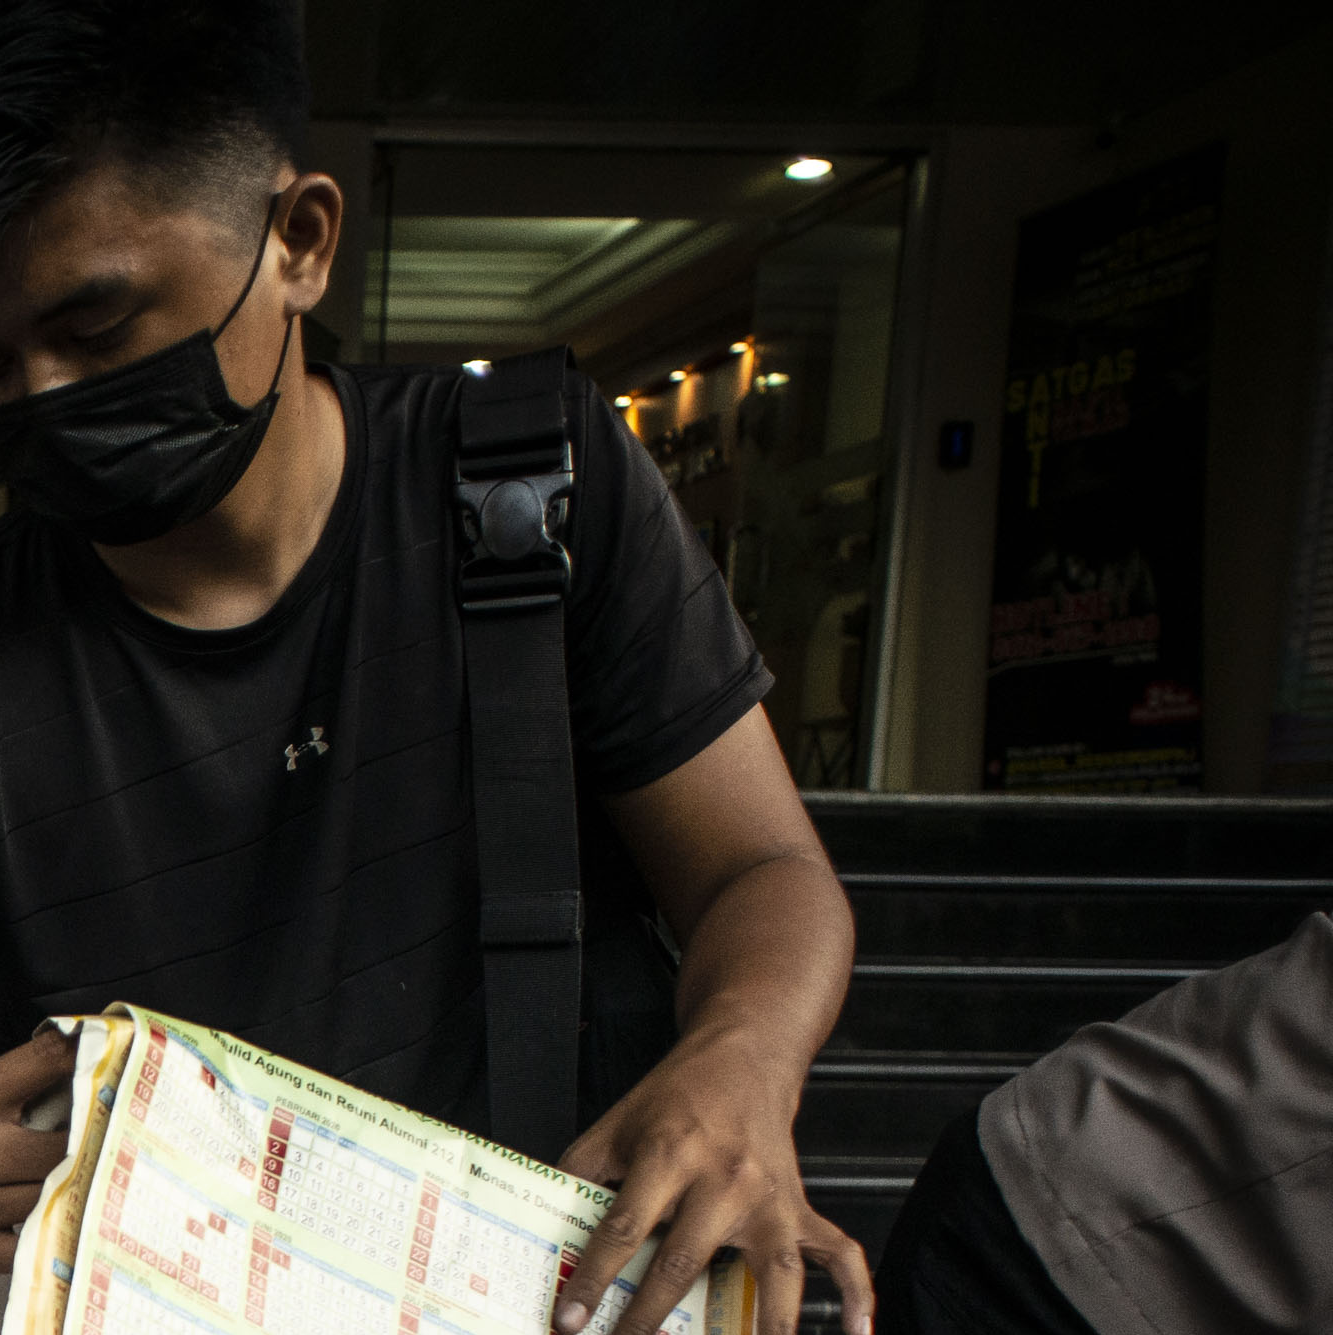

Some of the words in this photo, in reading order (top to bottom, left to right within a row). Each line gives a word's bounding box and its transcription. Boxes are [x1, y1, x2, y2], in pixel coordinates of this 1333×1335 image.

[254, 1052, 303, 1092] Agung
[306, 1078, 334, 1103] dan
[336, 1094, 378, 1127] Reuni
[379, 1116, 429, 1150] Alumni
[431, 1141, 458, 1166] 212
[469, 1163, 518, 1200] Monas,
[521, 1187, 532, 1204] 2
[534, 1197, 597, 1237] Desembe
[279, 1203, 294, 1219] 24
[301, 1213, 316, 1228] 25
[412, 1248, 428, 1263] 22
[409, 1265, 425, 1281] 29
